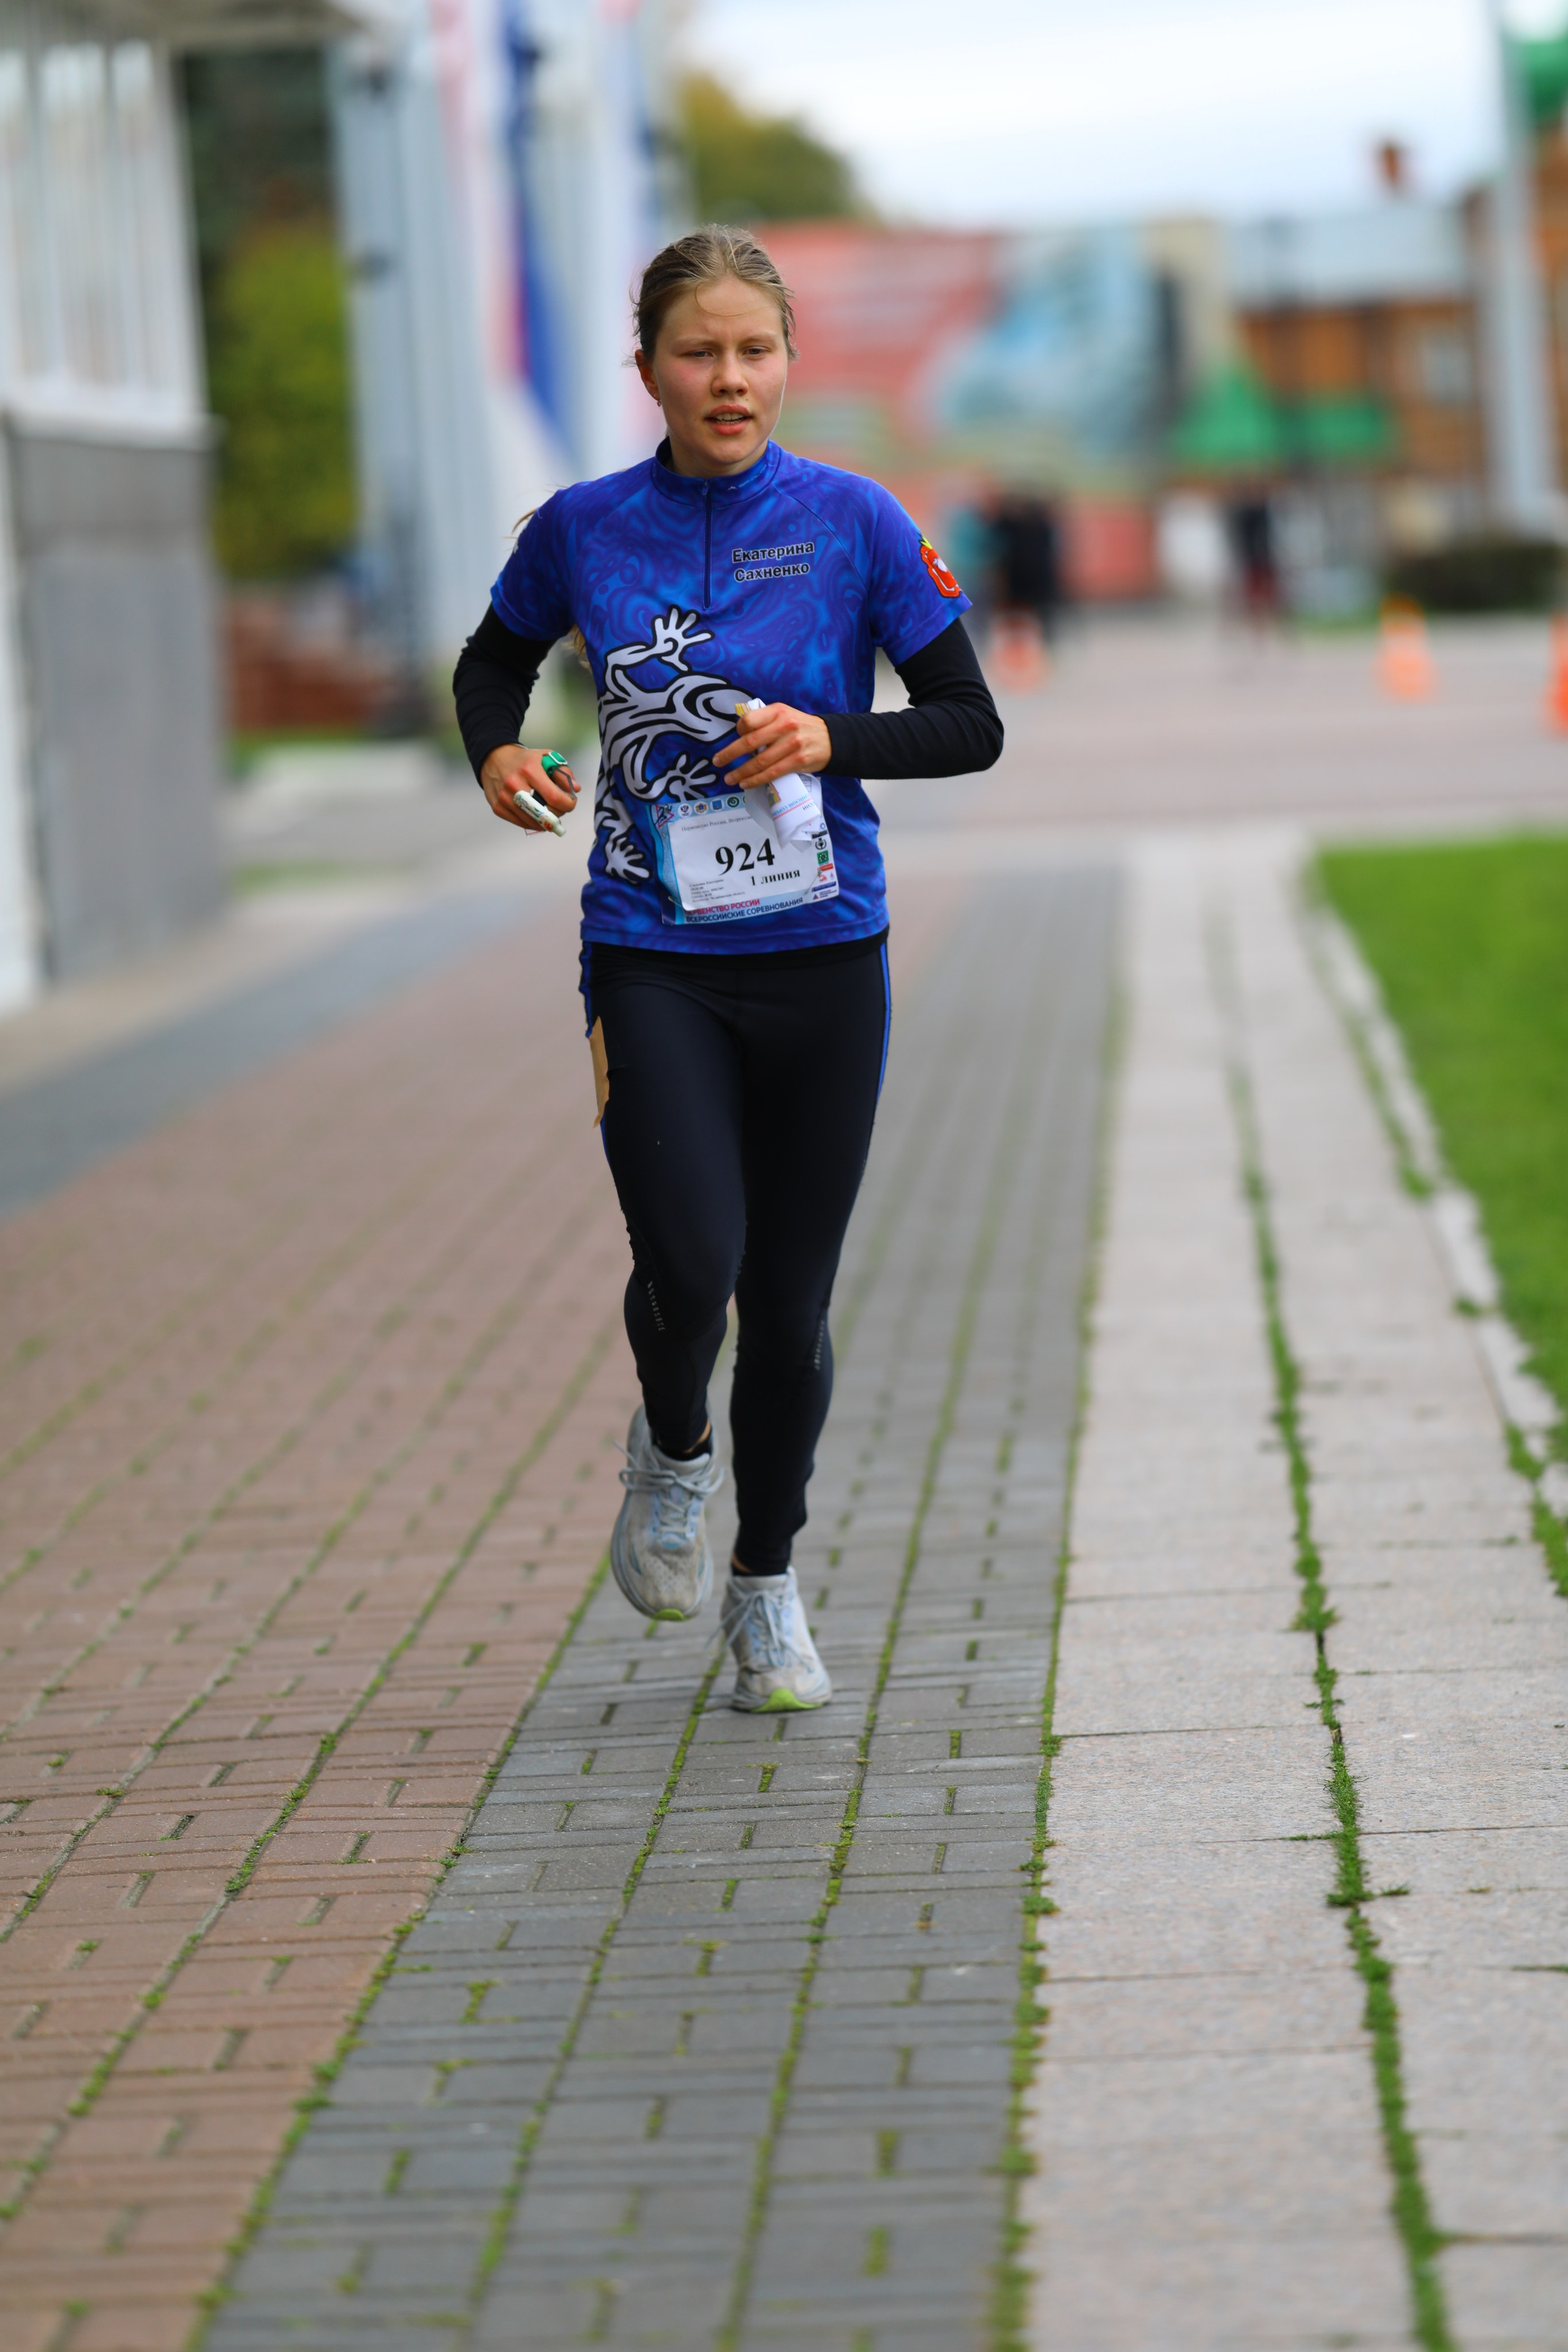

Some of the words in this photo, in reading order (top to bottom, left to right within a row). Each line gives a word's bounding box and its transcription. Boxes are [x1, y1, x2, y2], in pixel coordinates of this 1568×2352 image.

[732, 542, 815, 563] Екатерина
[734, 563, 810, 582] Сахненко
[715, 838, 775, 876] 924
[750, 876, 756, 886] 1
[761, 870, 801, 884] линия
[731, 899, 760, 909] РОССИИ
[746, 897, 803, 916] СОРЕВНОВАНИЯ
